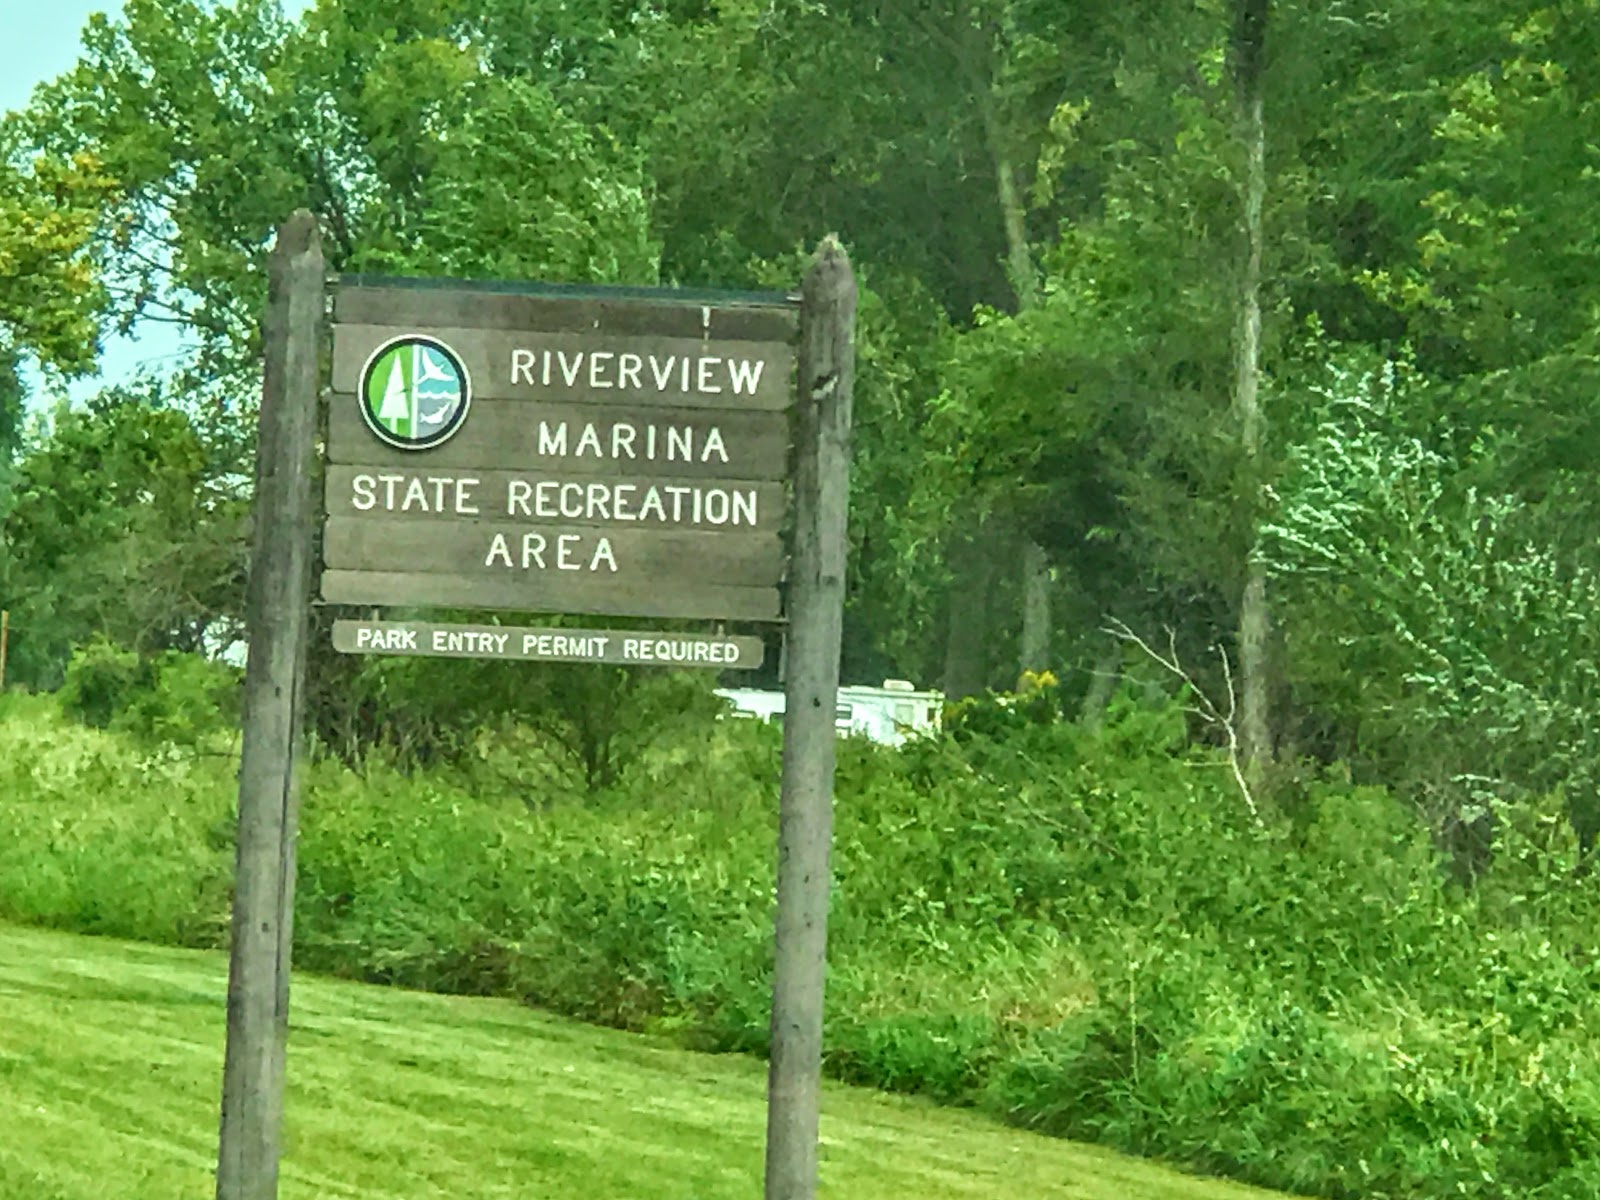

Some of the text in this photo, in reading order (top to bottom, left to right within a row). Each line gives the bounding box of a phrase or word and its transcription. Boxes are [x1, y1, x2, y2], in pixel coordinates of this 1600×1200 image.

[510, 349, 764, 395] RIVERVIEW
[538, 421, 729, 462] MARINA
[352, 474, 757, 526] STATE RECREATION
[485, 533, 618, 571] AREA
[357, 628, 740, 663] PARK ENTRY PERMIT REQUIRED
